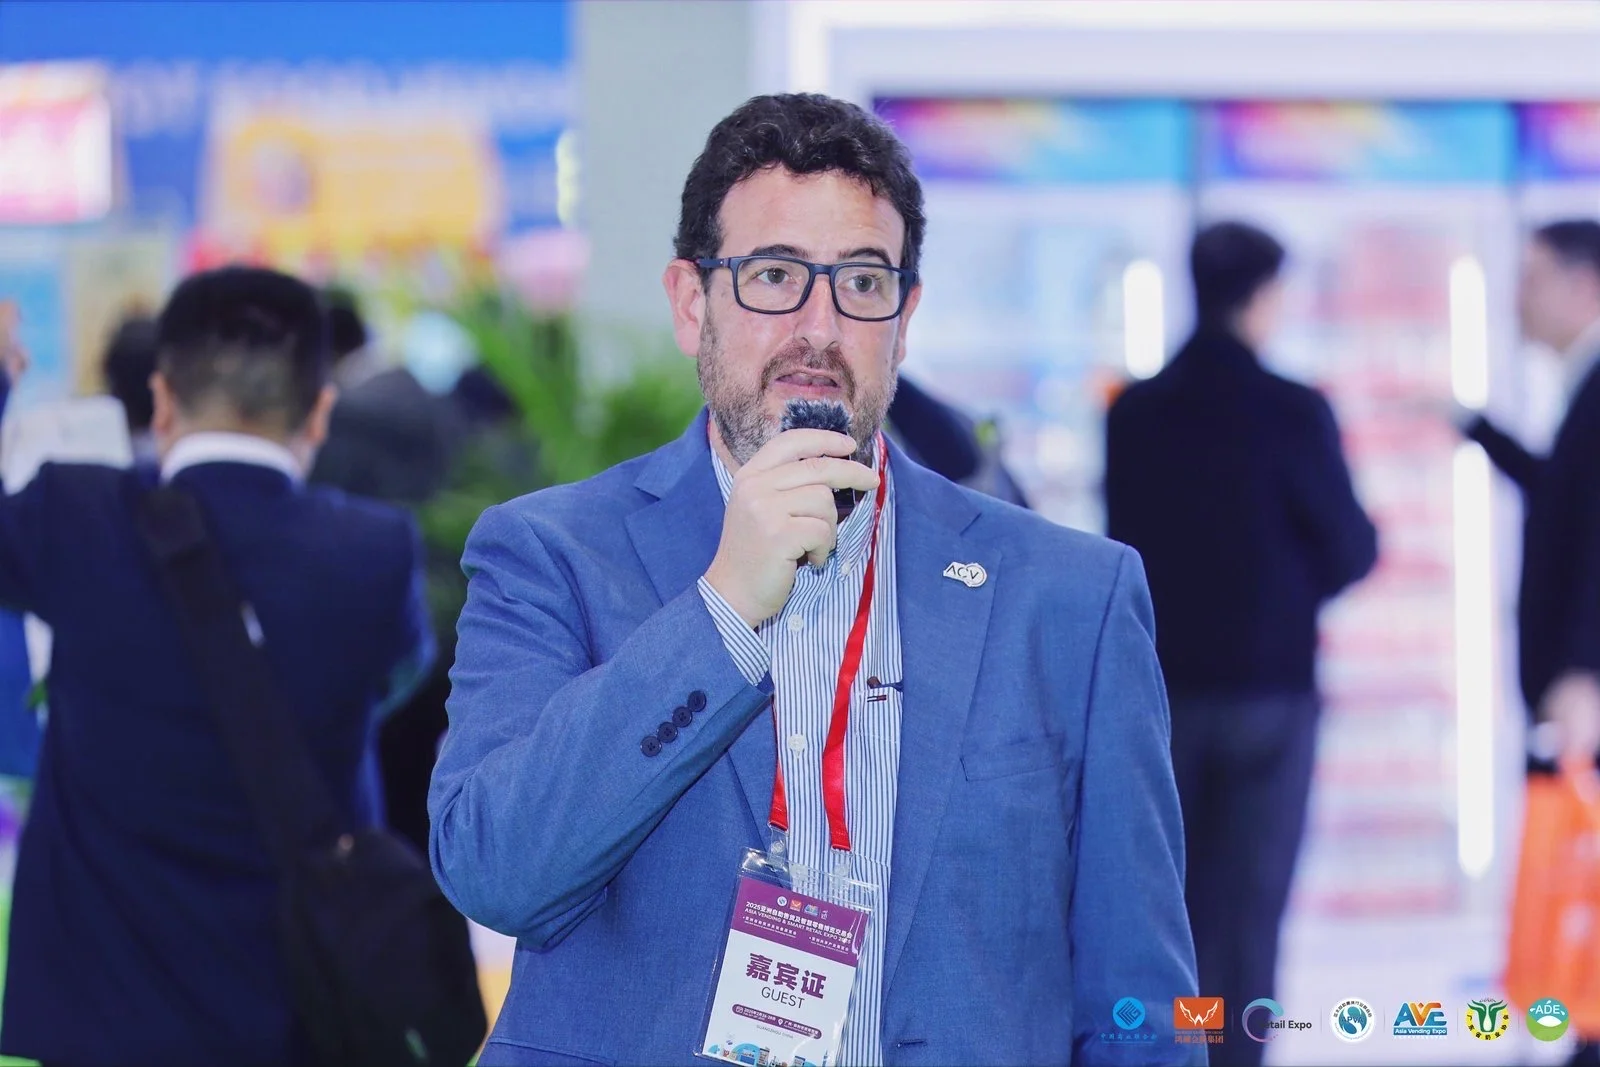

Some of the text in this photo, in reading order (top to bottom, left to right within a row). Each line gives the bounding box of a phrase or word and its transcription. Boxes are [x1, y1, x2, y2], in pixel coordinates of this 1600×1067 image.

[946, 565, 979, 579] ACV
[745, 908, 757, 916] ASIA
[758, 911, 781, 923] VENDING
[787, 920, 805, 930] SMART
[806, 925, 823, 936] RETAIL
[824, 931, 838, 940] EXPO
[746, 953, 826, 999] 嘉宾证
[761, 986, 805, 1008] GUEST
